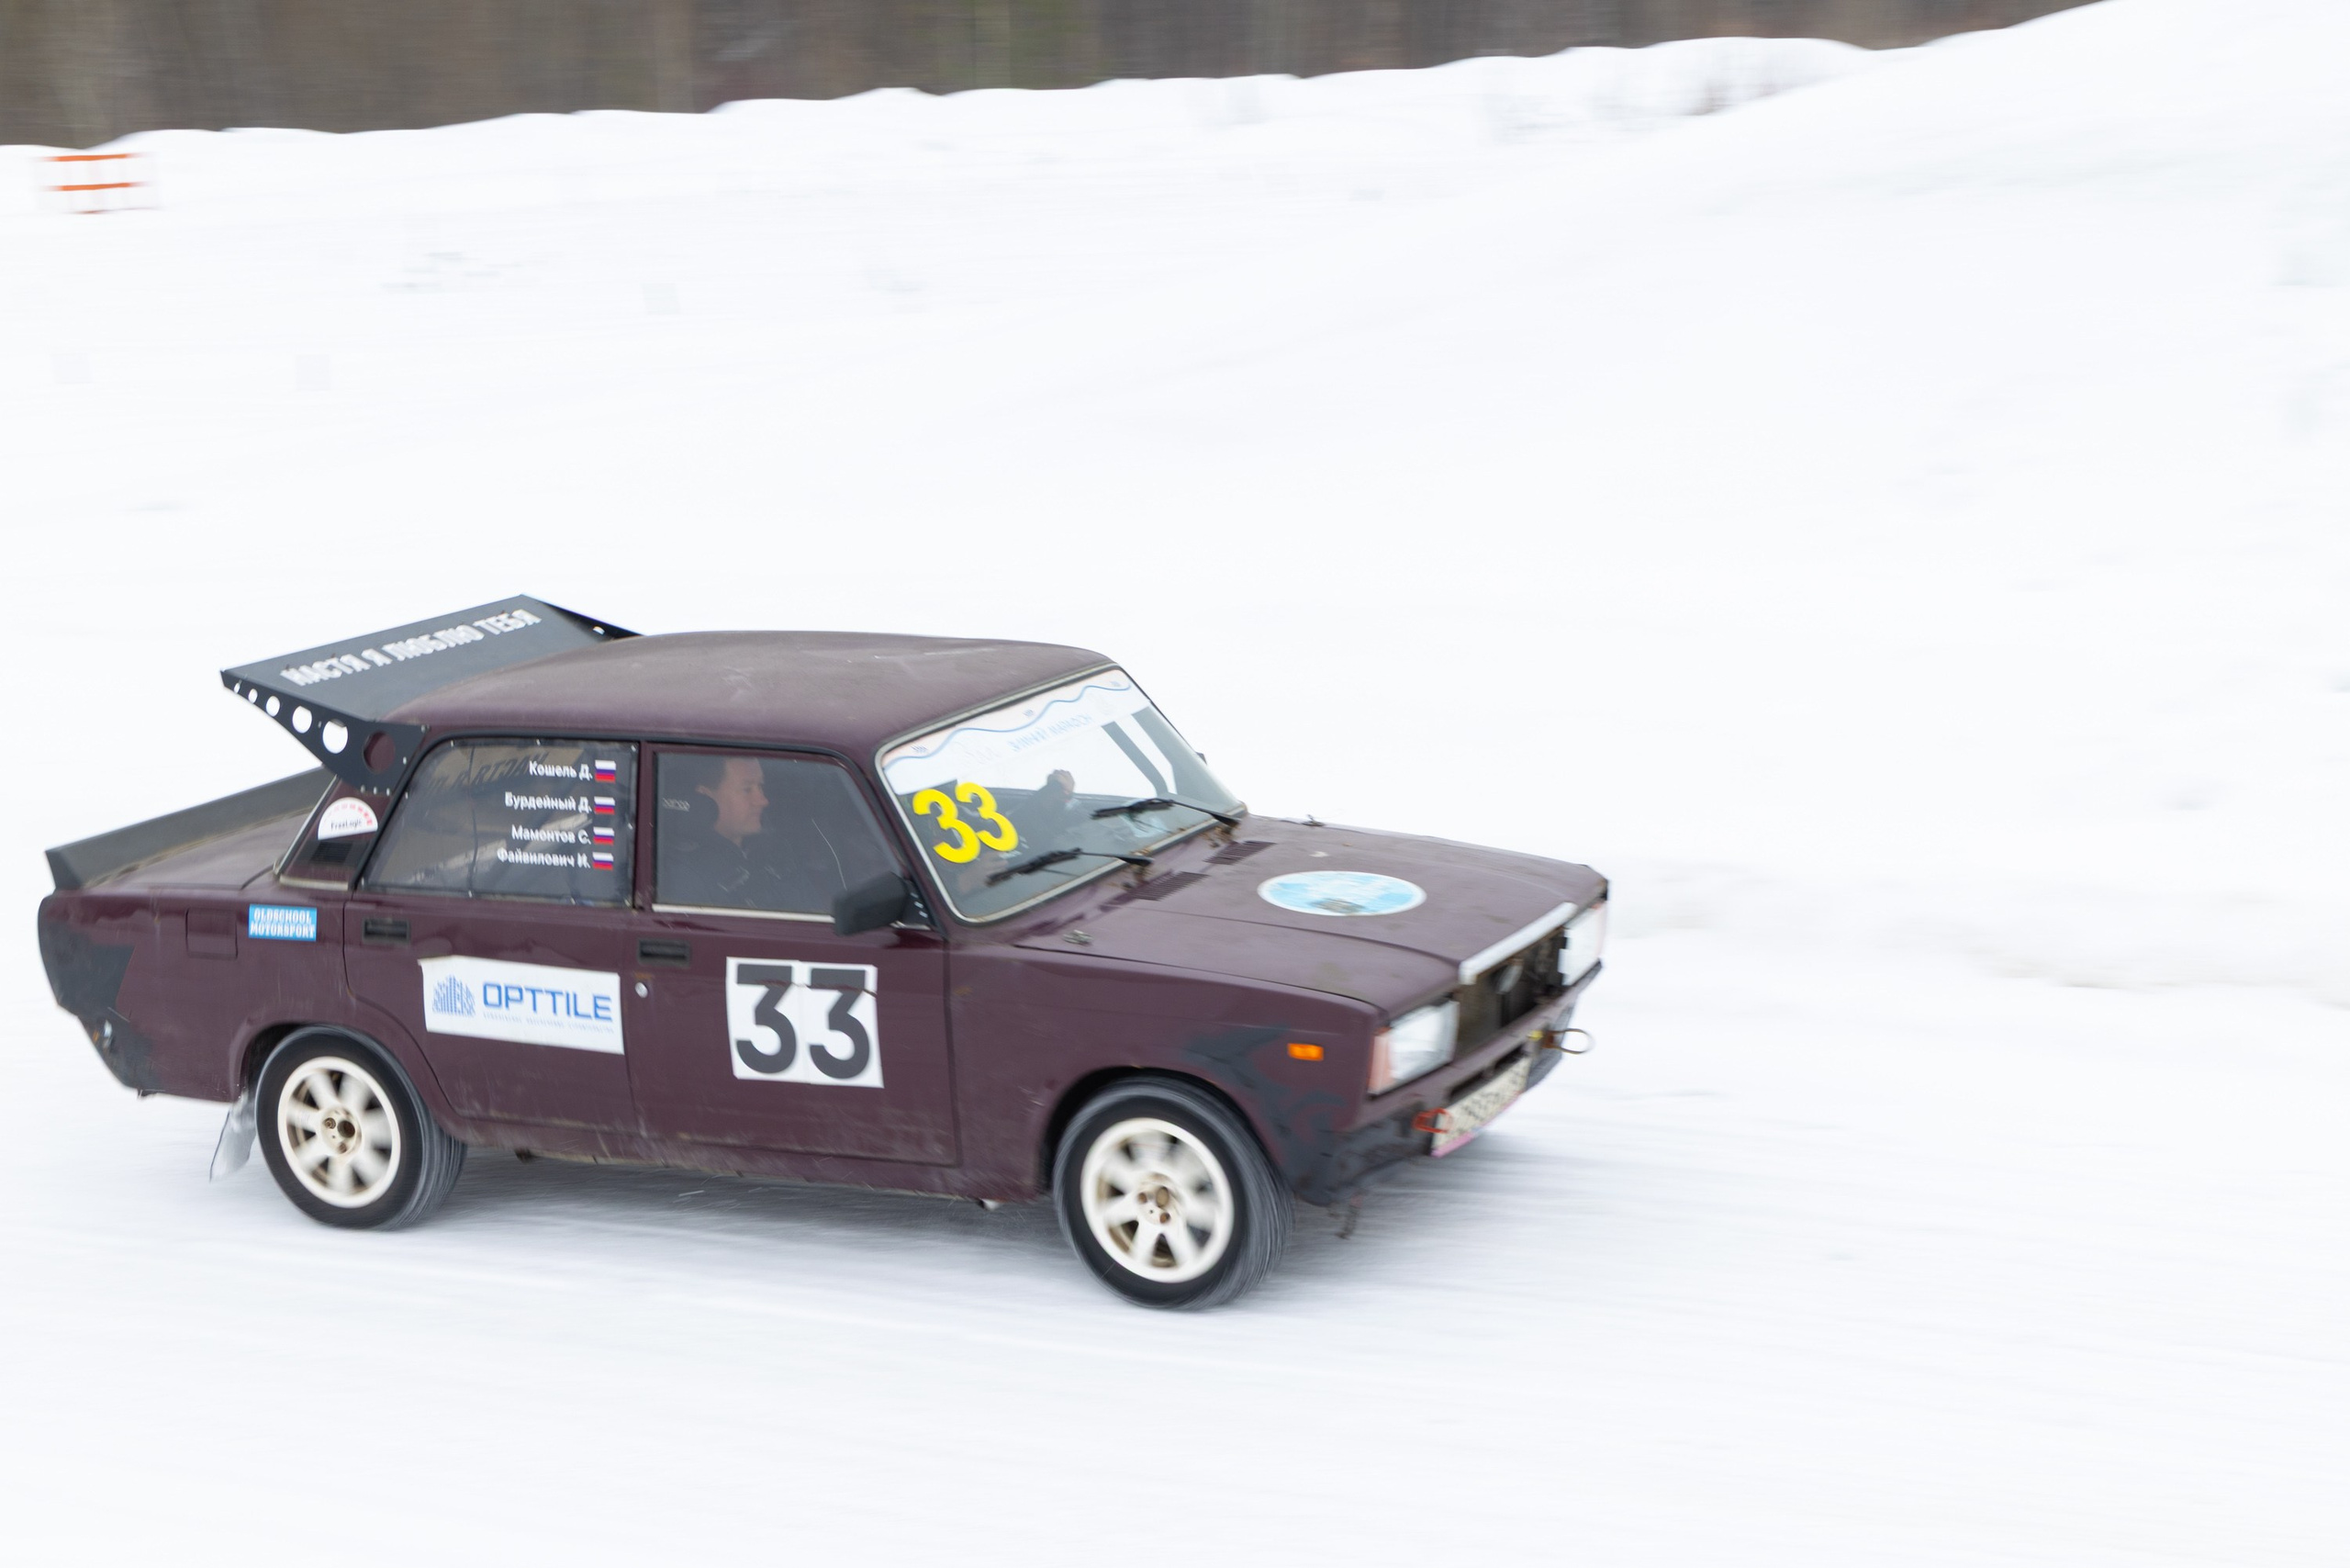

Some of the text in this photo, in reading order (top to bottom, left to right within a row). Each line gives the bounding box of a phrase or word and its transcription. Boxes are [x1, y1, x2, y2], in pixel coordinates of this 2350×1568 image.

[280, 609, 543, 687] НАСТЯ Я ЛЮБЛЮ ТЕБЯ
[528, 760, 593, 780] Кошель Д.
[505, 791, 592, 813] Бурдейный Д.
[912, 782, 1018, 864] 33
[511, 824, 576, 844] Мамонтов
[497, 847, 575, 868] Файвилович
[253, 907, 312, 923] OLDSCHOOL
[250, 922, 315, 938] MOTORSPORT
[482, 982, 613, 1023] OPTTILE
[735, 963, 870, 1080] 33
